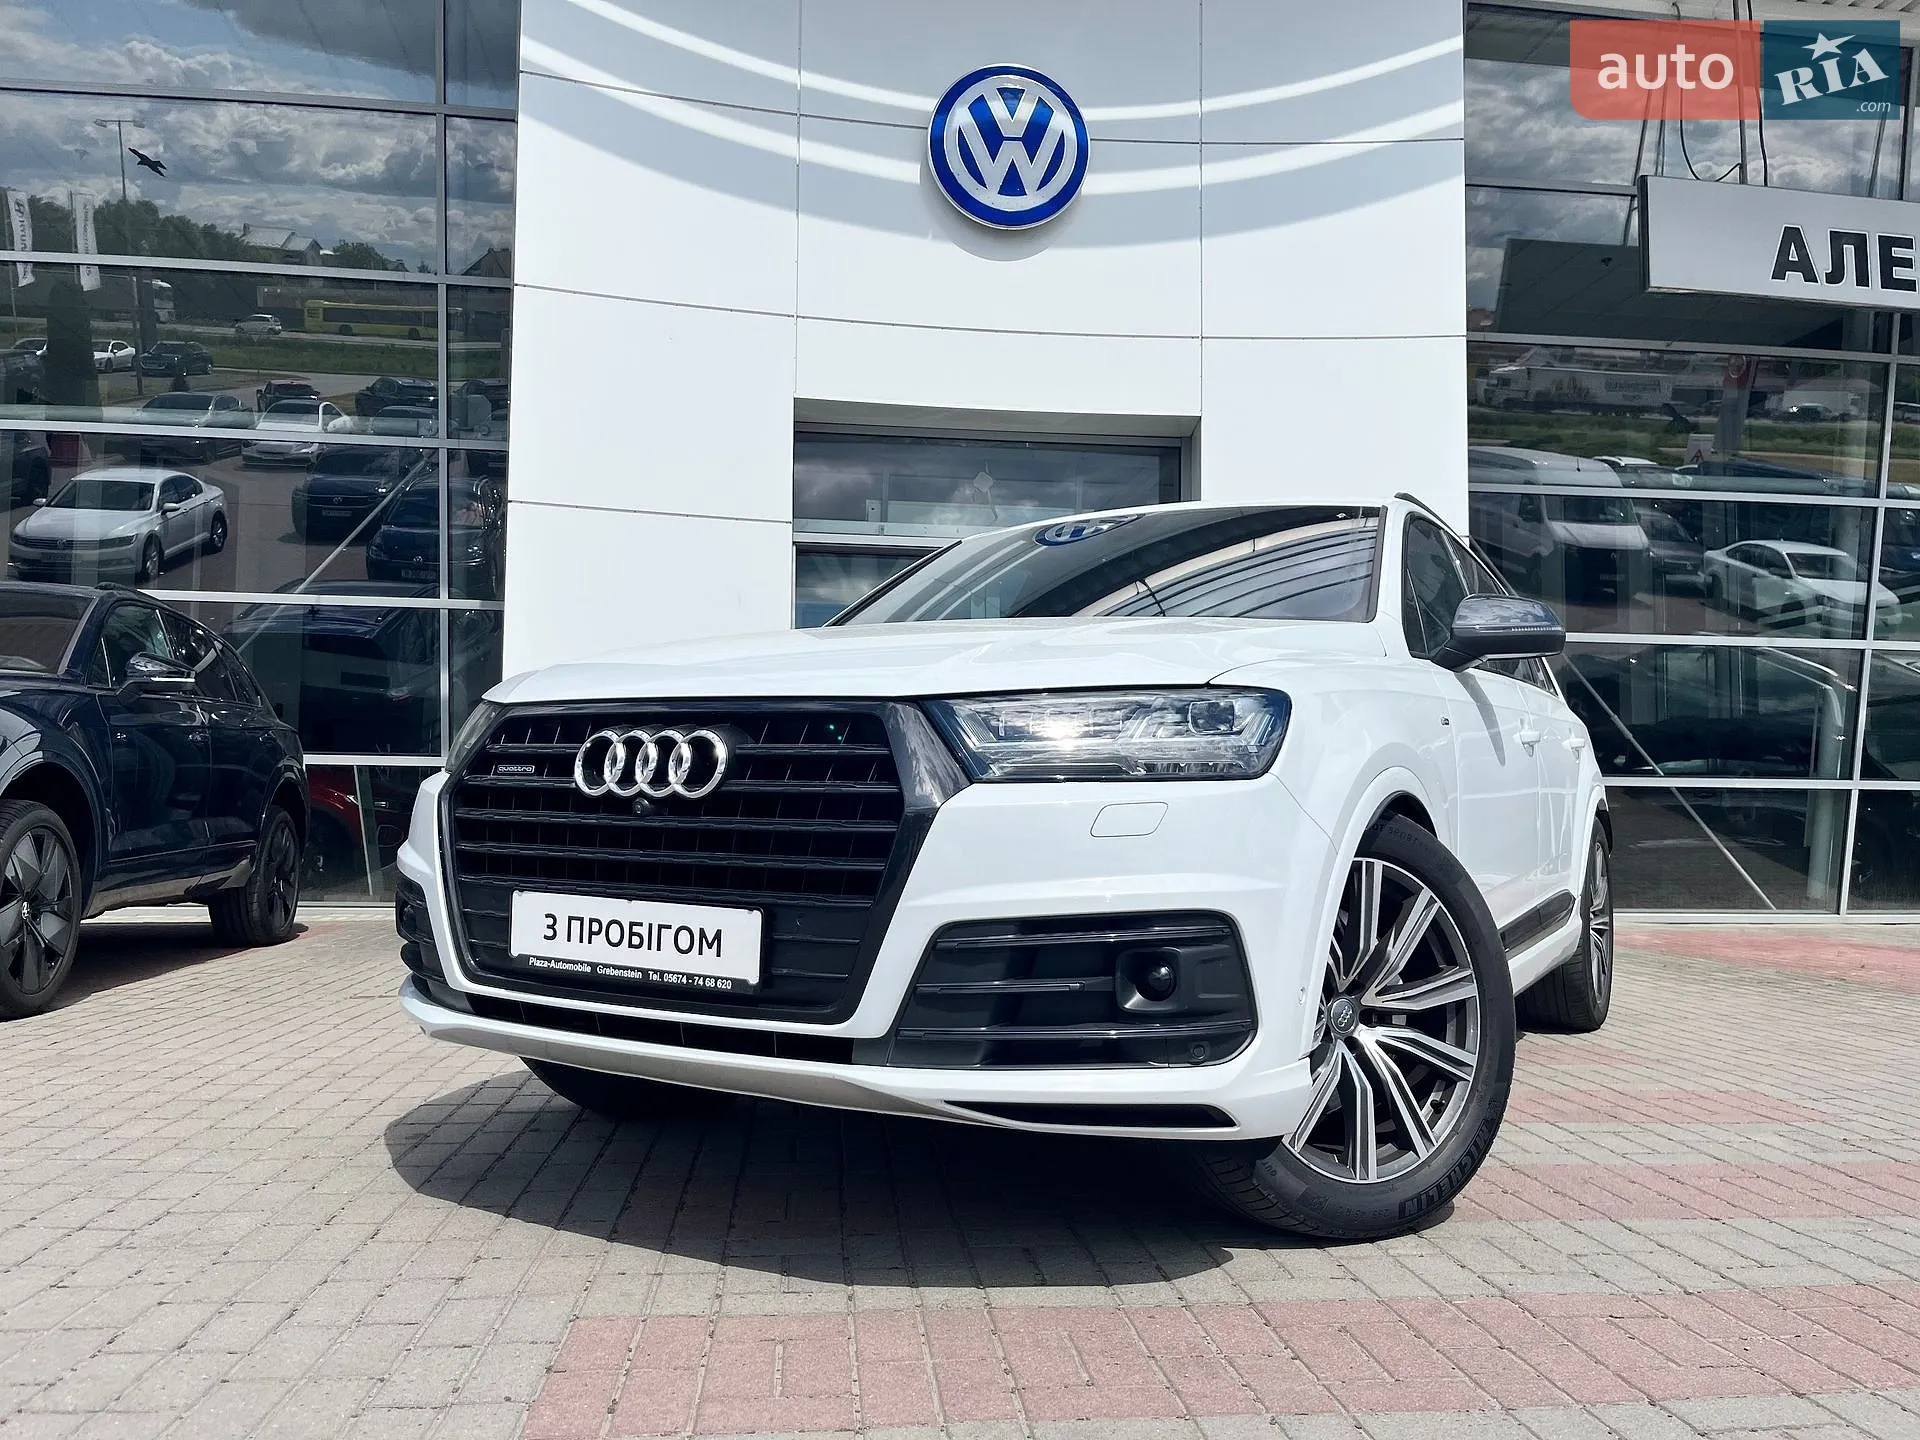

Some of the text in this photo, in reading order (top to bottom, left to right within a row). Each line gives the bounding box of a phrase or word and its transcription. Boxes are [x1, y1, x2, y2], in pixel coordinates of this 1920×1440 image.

[1770, 225, 1918, 292] АЛЕ
[566, 915, 723, 958] ПРОБІГОМ
[528, 956, 592, 973] Plaza-Automobile
[596, 964, 643, 979] Grebenstein
[648, 970, 662, 981] Tel.
[663, 973, 687, 984] 05674
[693, 976, 704, 986] 74
[705, 977, 715, 988] 68
[716, 978, 732, 989] 620
